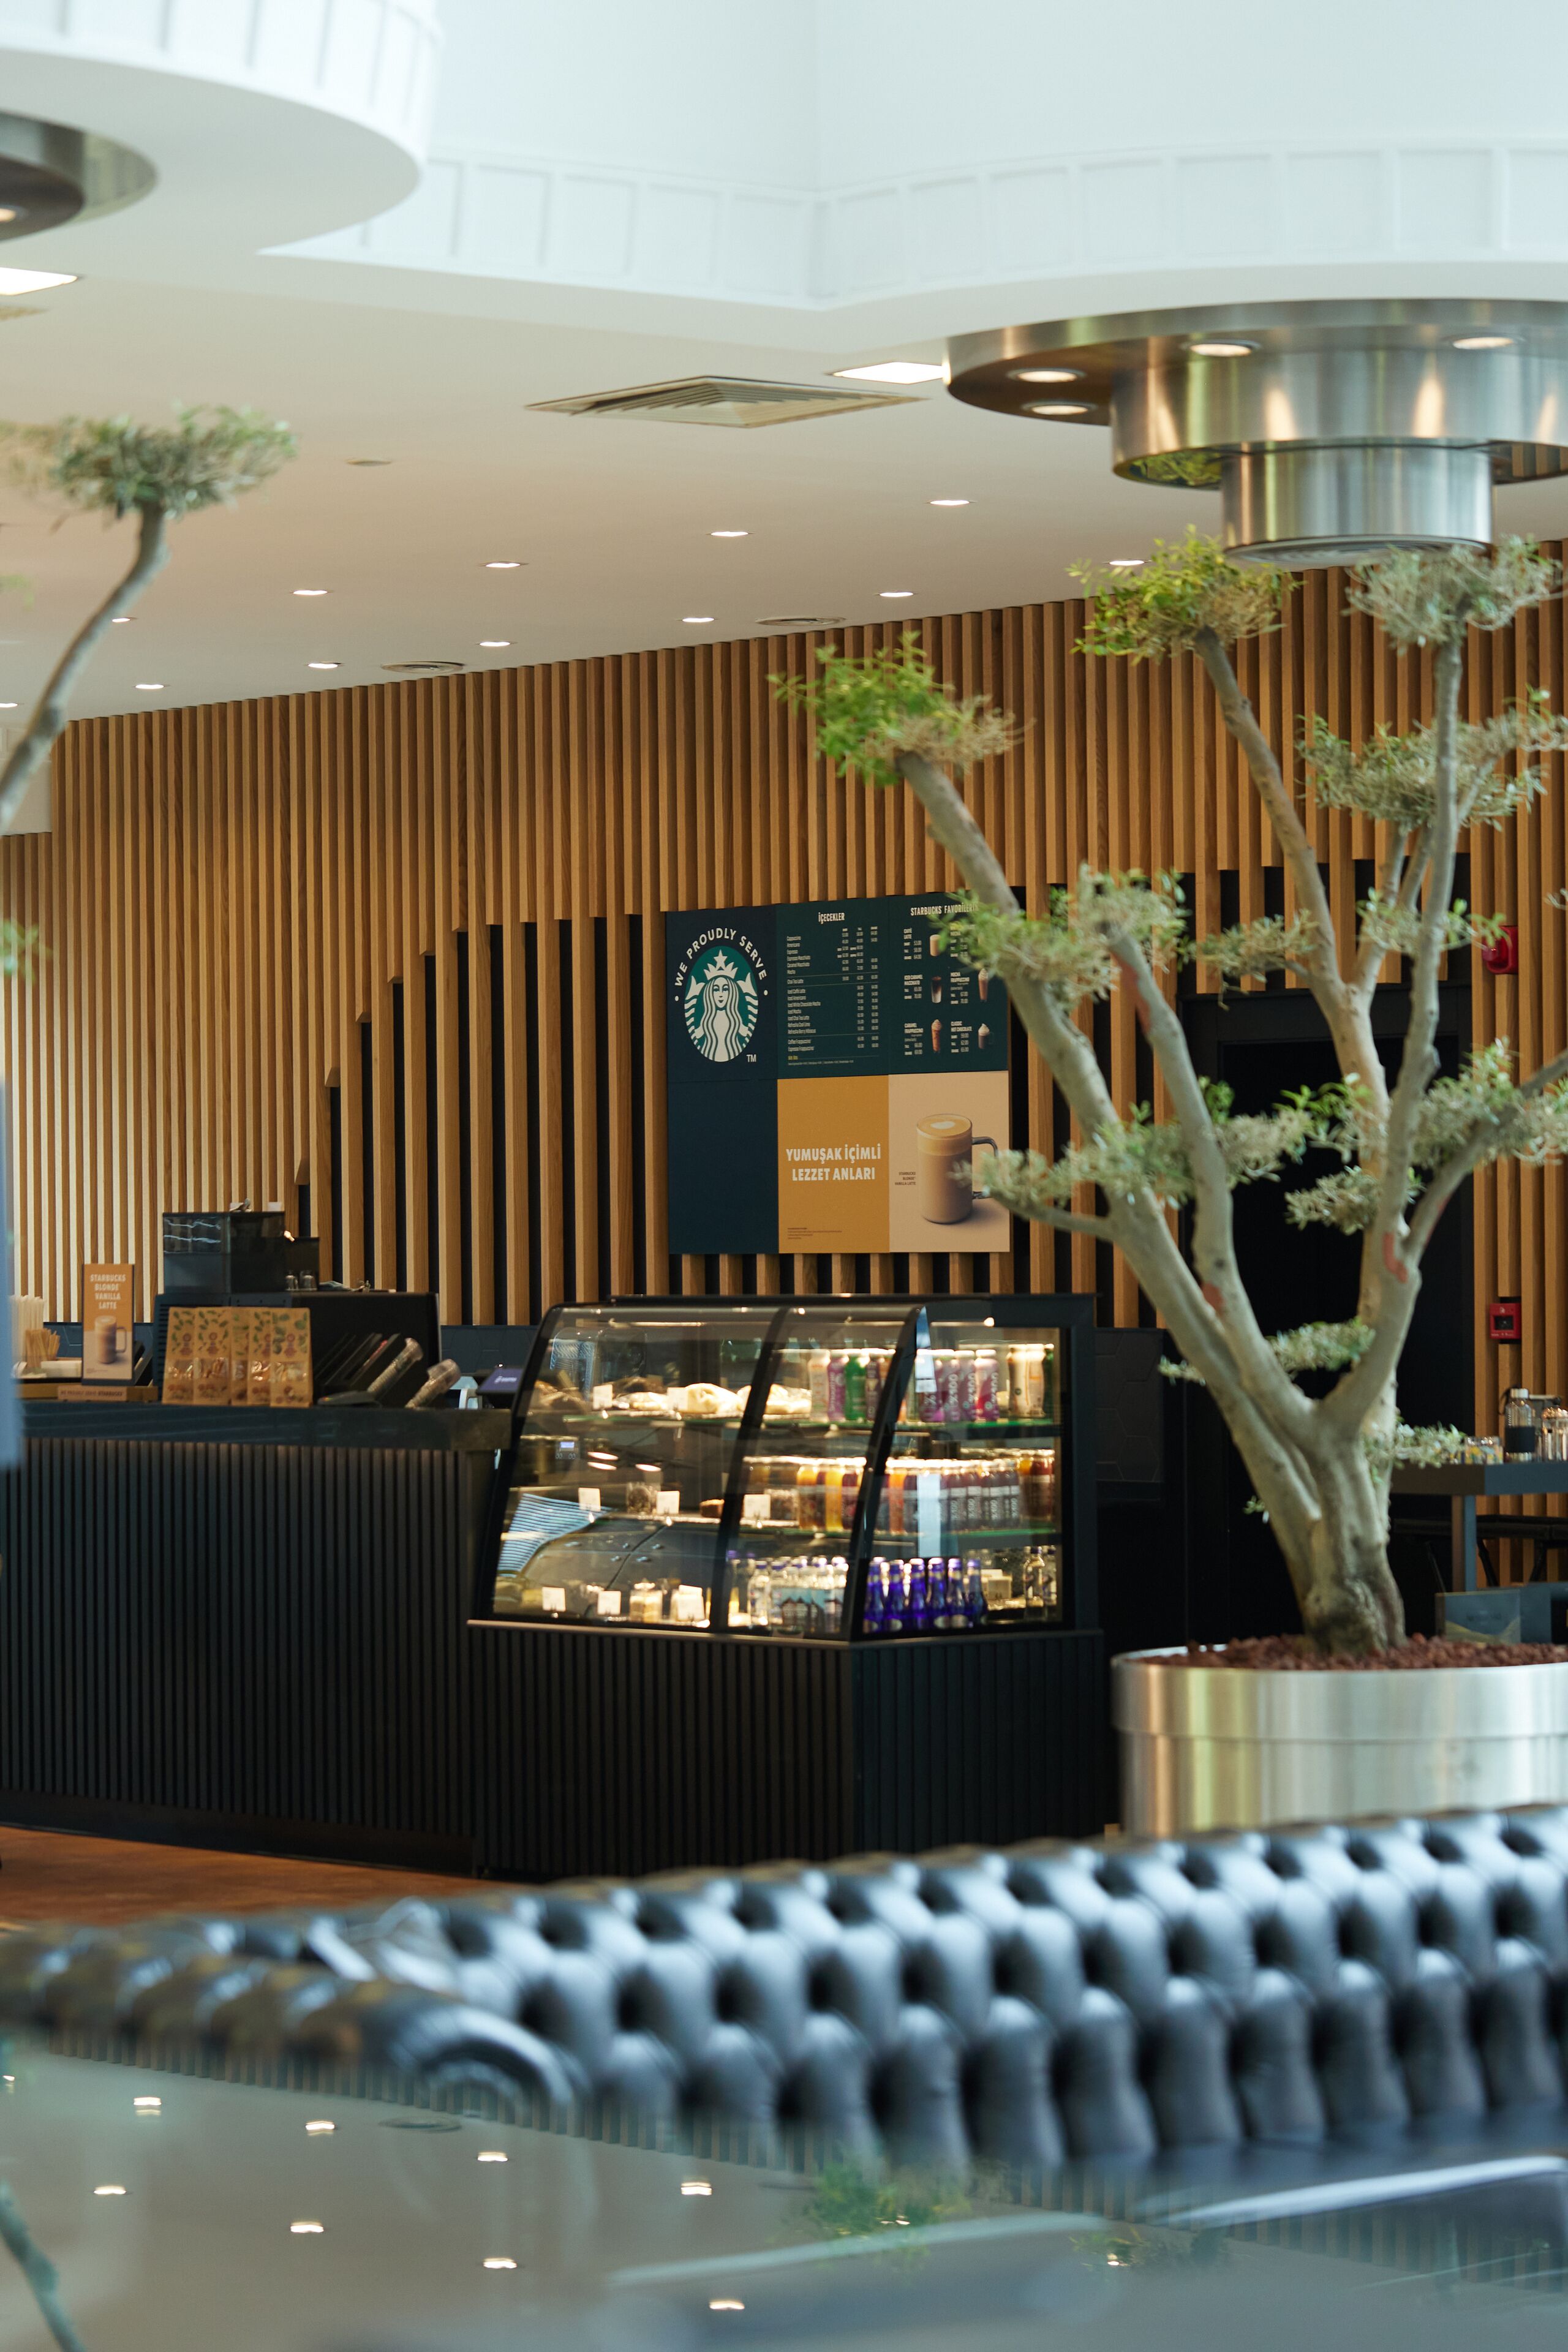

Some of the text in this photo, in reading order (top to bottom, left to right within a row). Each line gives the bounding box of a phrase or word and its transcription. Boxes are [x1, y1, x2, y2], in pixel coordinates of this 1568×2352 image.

[910, 905, 942, 916] STARBUCKS
[818, 911, 845, 924] İÇECEKLER
[674, 927, 767, 986] WE PROUDLY SERVE
[746, 1054, 756, 1063] TM
[786, 1143, 881, 1164] YUMUŞAK İÇİMLİ
[792, 1167, 876, 1182] LEZZET ANLARI
[90, 1273, 126, 1283] STARBUCKS
[98, 1302, 117, 1310] LATTE
